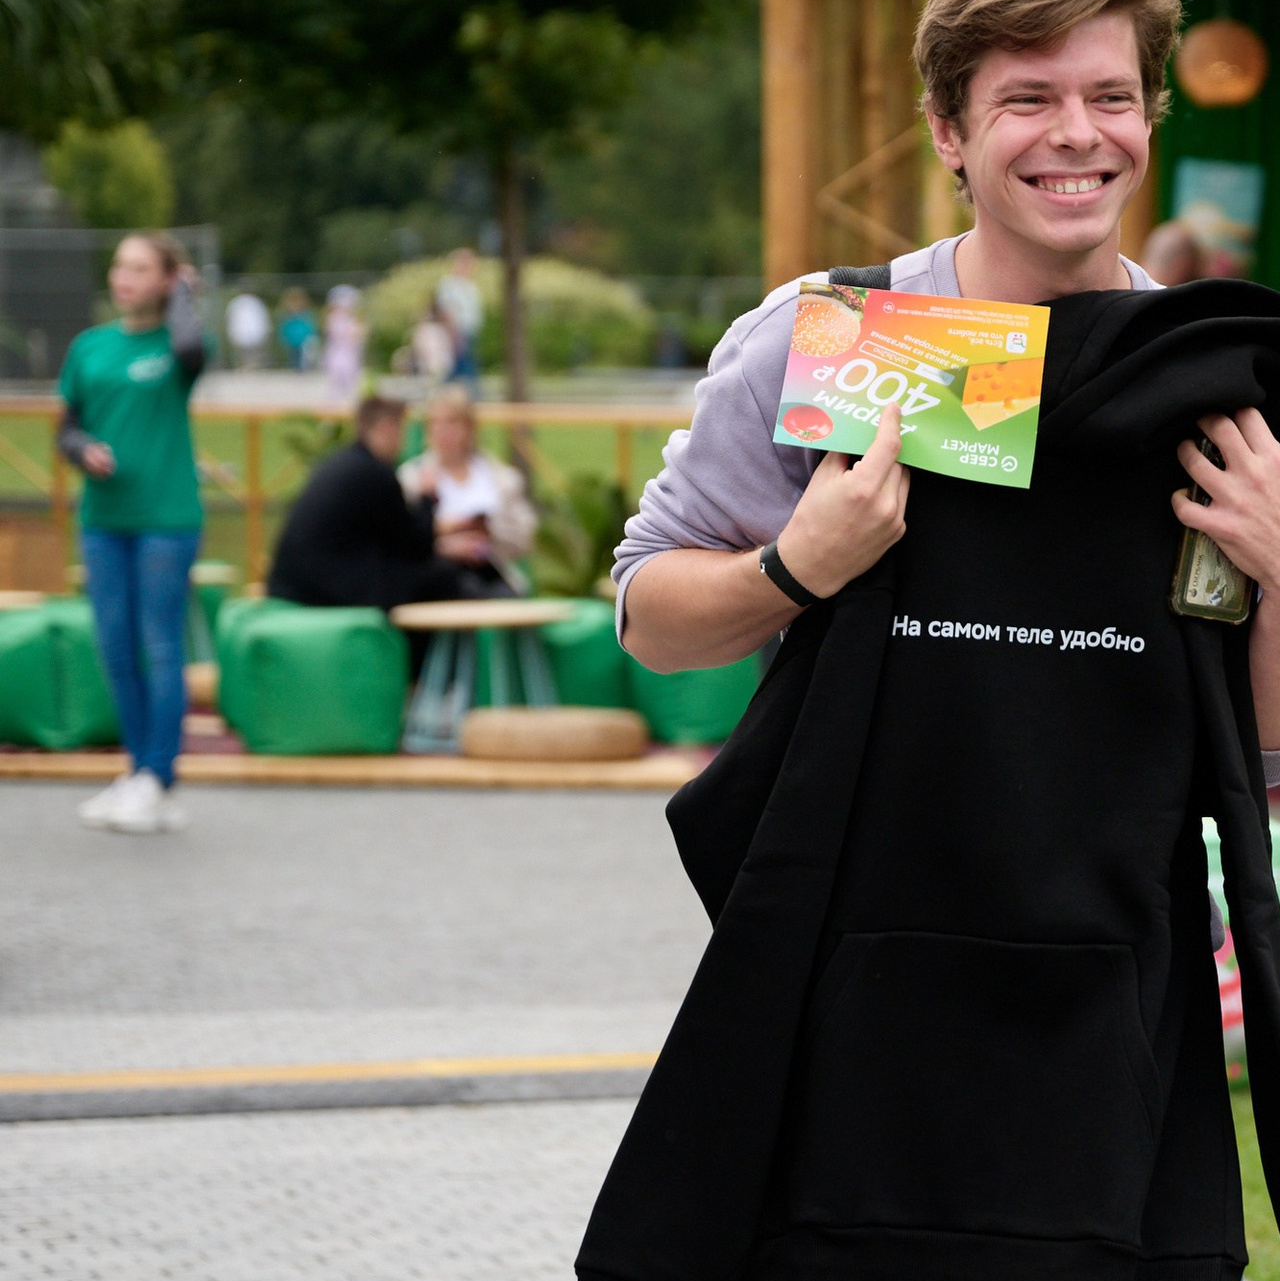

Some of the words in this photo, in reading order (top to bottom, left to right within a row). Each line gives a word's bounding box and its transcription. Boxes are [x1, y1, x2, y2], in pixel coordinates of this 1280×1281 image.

[870, 331, 910, 351] магазина
[948, 328, 978, 338] любите
[903, 334, 951, 357] ресторана
[913, 347, 923, 356] из
[924, 352, 950, 369] заказ
[835, 358, 941, 417] 400
[941, 439, 1000, 455] МАРКЕТ
[960, 453, 998, 467] СБЕР
[892, 615, 921, 636] На
[928, 620, 1000, 641] самом
[1006, 624, 1054, 645] теле
[1060, 627, 1145, 653] удобно
